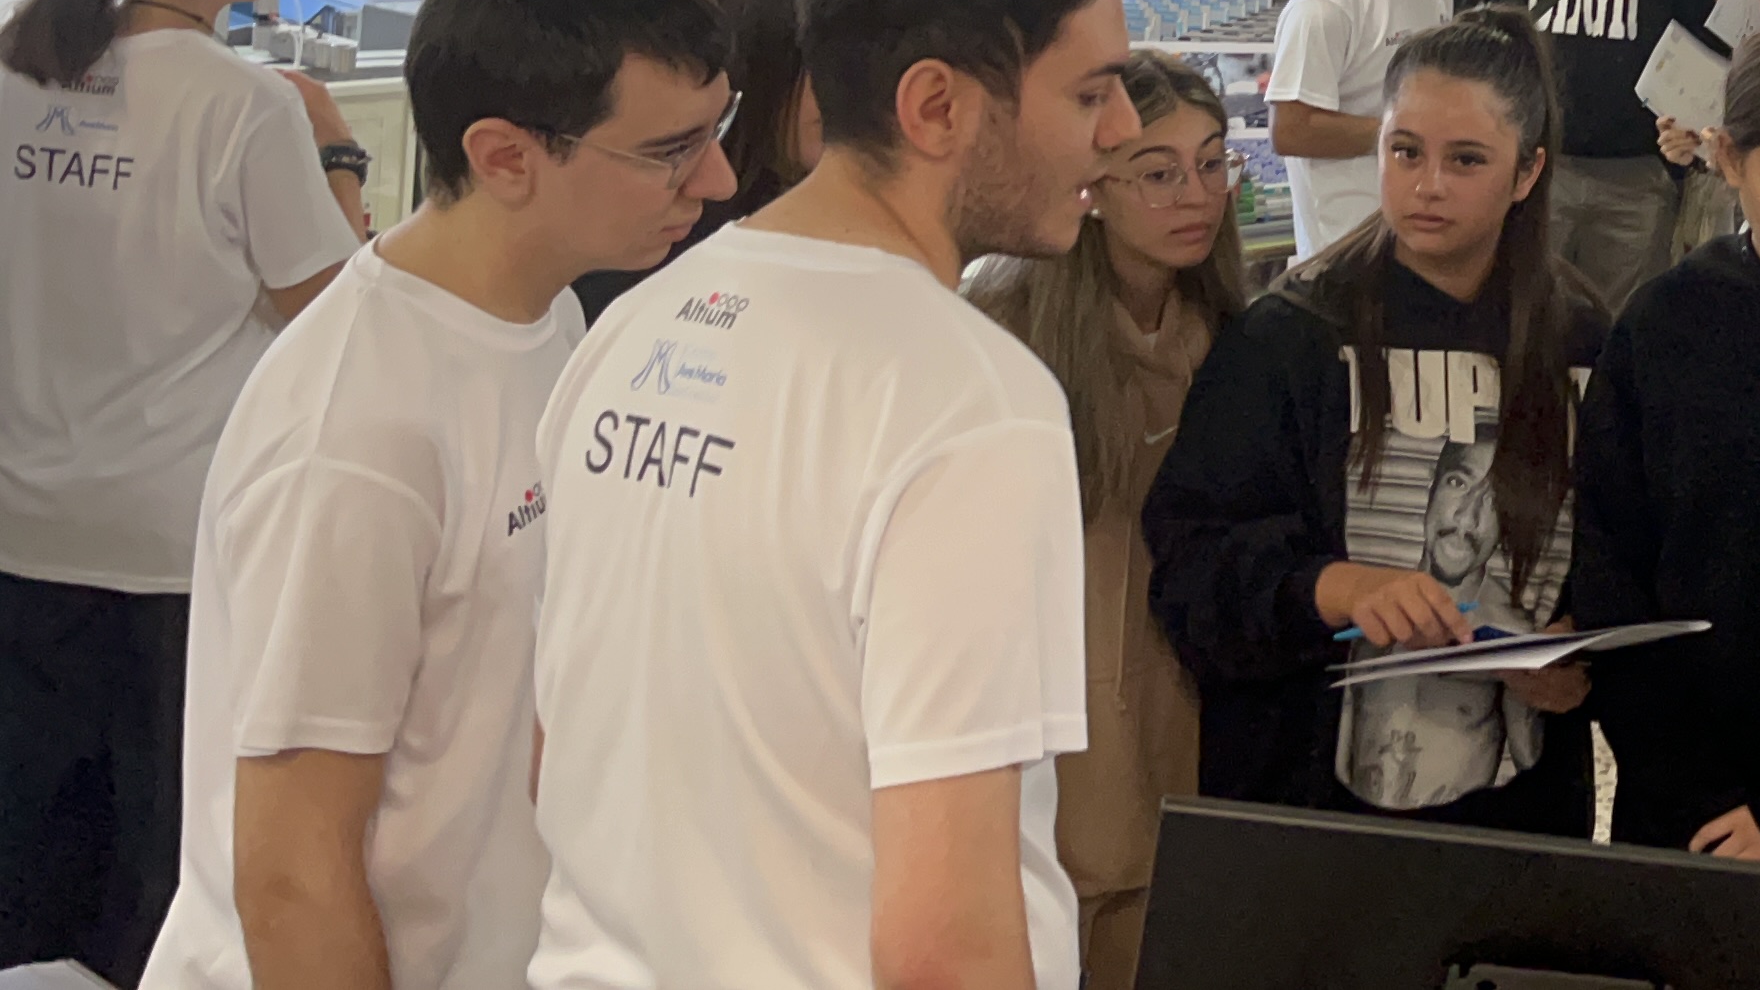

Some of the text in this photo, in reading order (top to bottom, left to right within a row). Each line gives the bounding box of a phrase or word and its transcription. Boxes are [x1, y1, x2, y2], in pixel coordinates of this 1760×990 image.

[14, 144, 134, 190] STAFF
[675, 294, 738, 330] Altium
[585, 409, 736, 498] STAFF
[507, 493, 547, 537] Altiu
